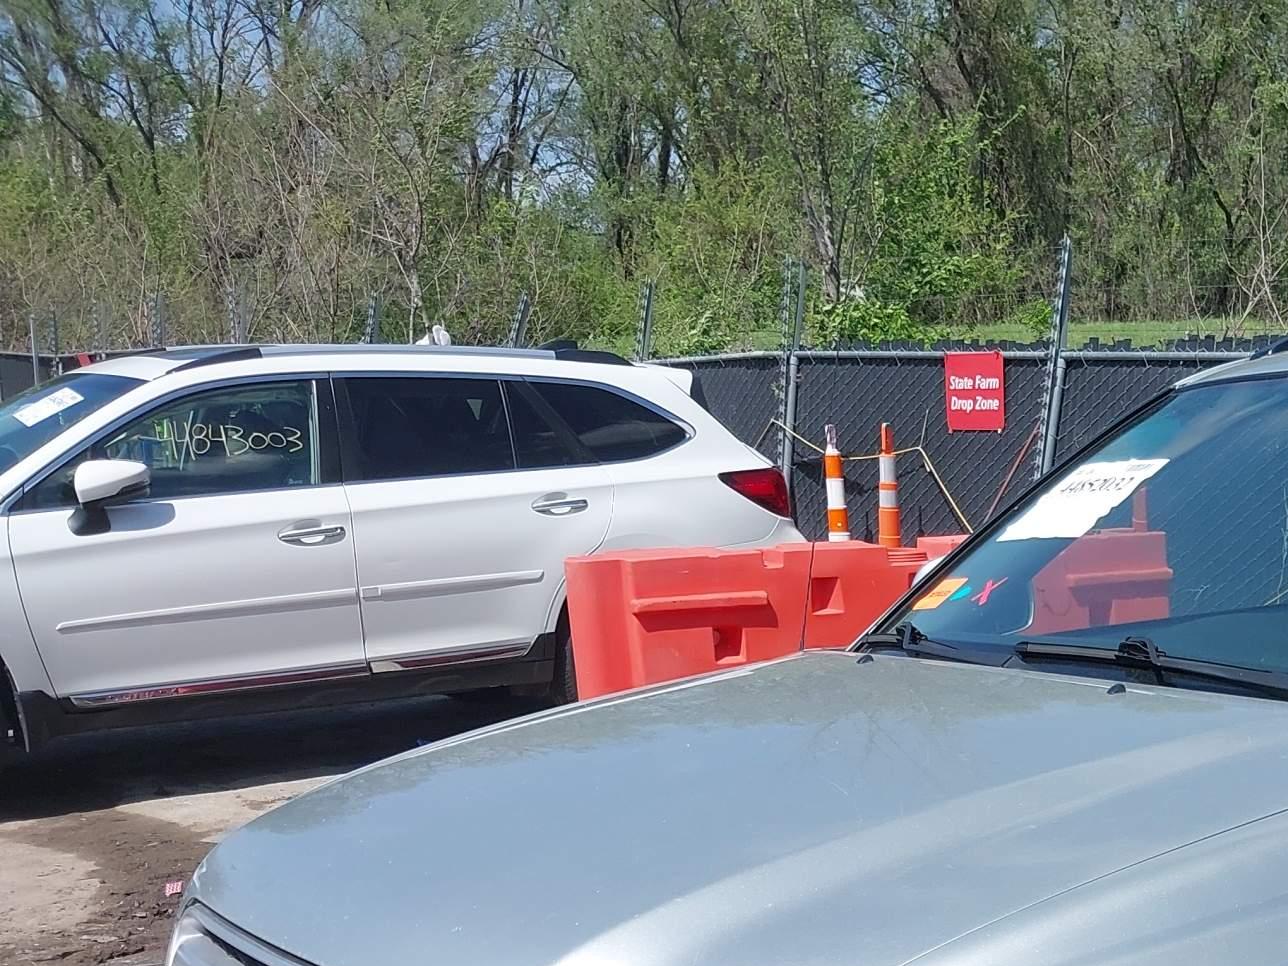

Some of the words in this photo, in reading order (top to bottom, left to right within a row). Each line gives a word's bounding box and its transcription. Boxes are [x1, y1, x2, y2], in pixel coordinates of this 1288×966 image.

[949, 376, 974, 390] State
[975, 375, 1000, 390] Farm
[951, 396, 974, 413] Drop
[975, 396, 1000, 410] Zone
[155, 411, 303, 472] 44843003
